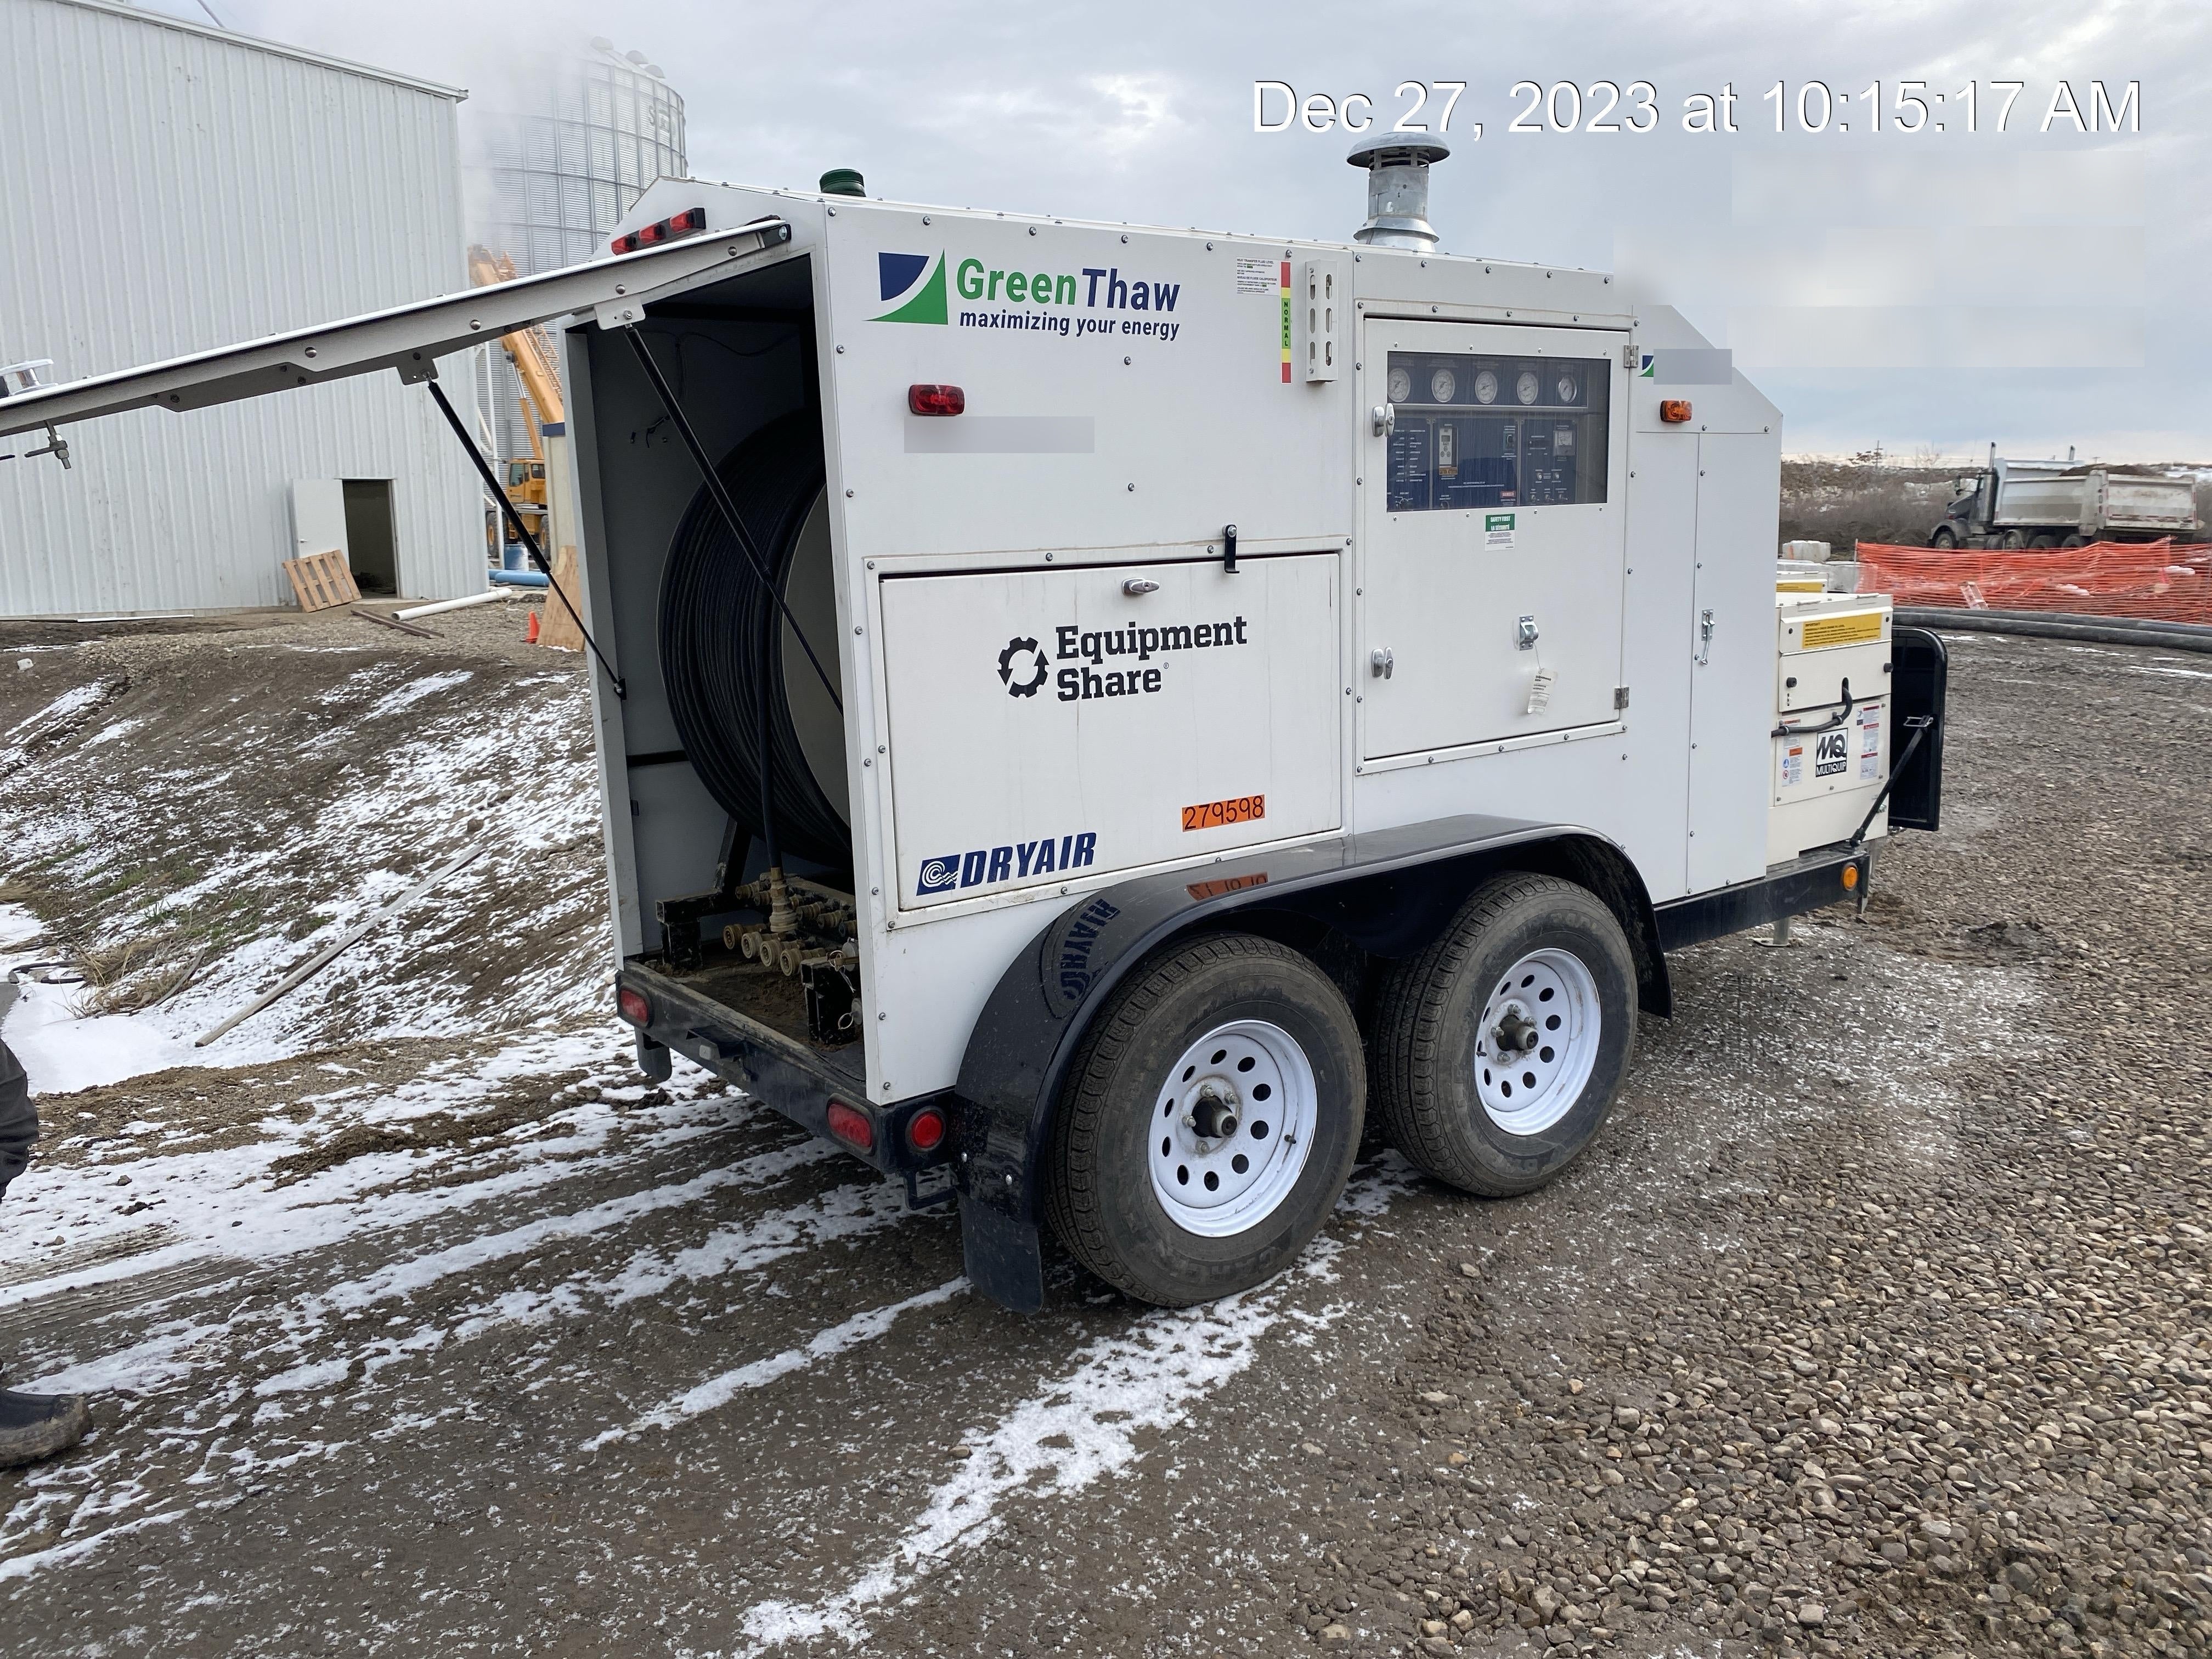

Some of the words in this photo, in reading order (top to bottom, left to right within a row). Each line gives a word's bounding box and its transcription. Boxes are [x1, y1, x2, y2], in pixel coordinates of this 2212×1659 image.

[957, 258, 1181, 312] GreenThaw
[960, 309, 1070, 337] maximizing
[1076, 318, 1116, 337] your
[1122, 320, 1181, 341] energy
[1056, 616, 1248, 665] Equipment
[1057, 667, 1162, 702] Share
[1817, 733, 1847, 760] MQ
[1816, 761, 1847, 776] MULTIQUIP
[1184, 795, 1264, 830] 279598
[960, 832, 1097, 889] DRYAIR
